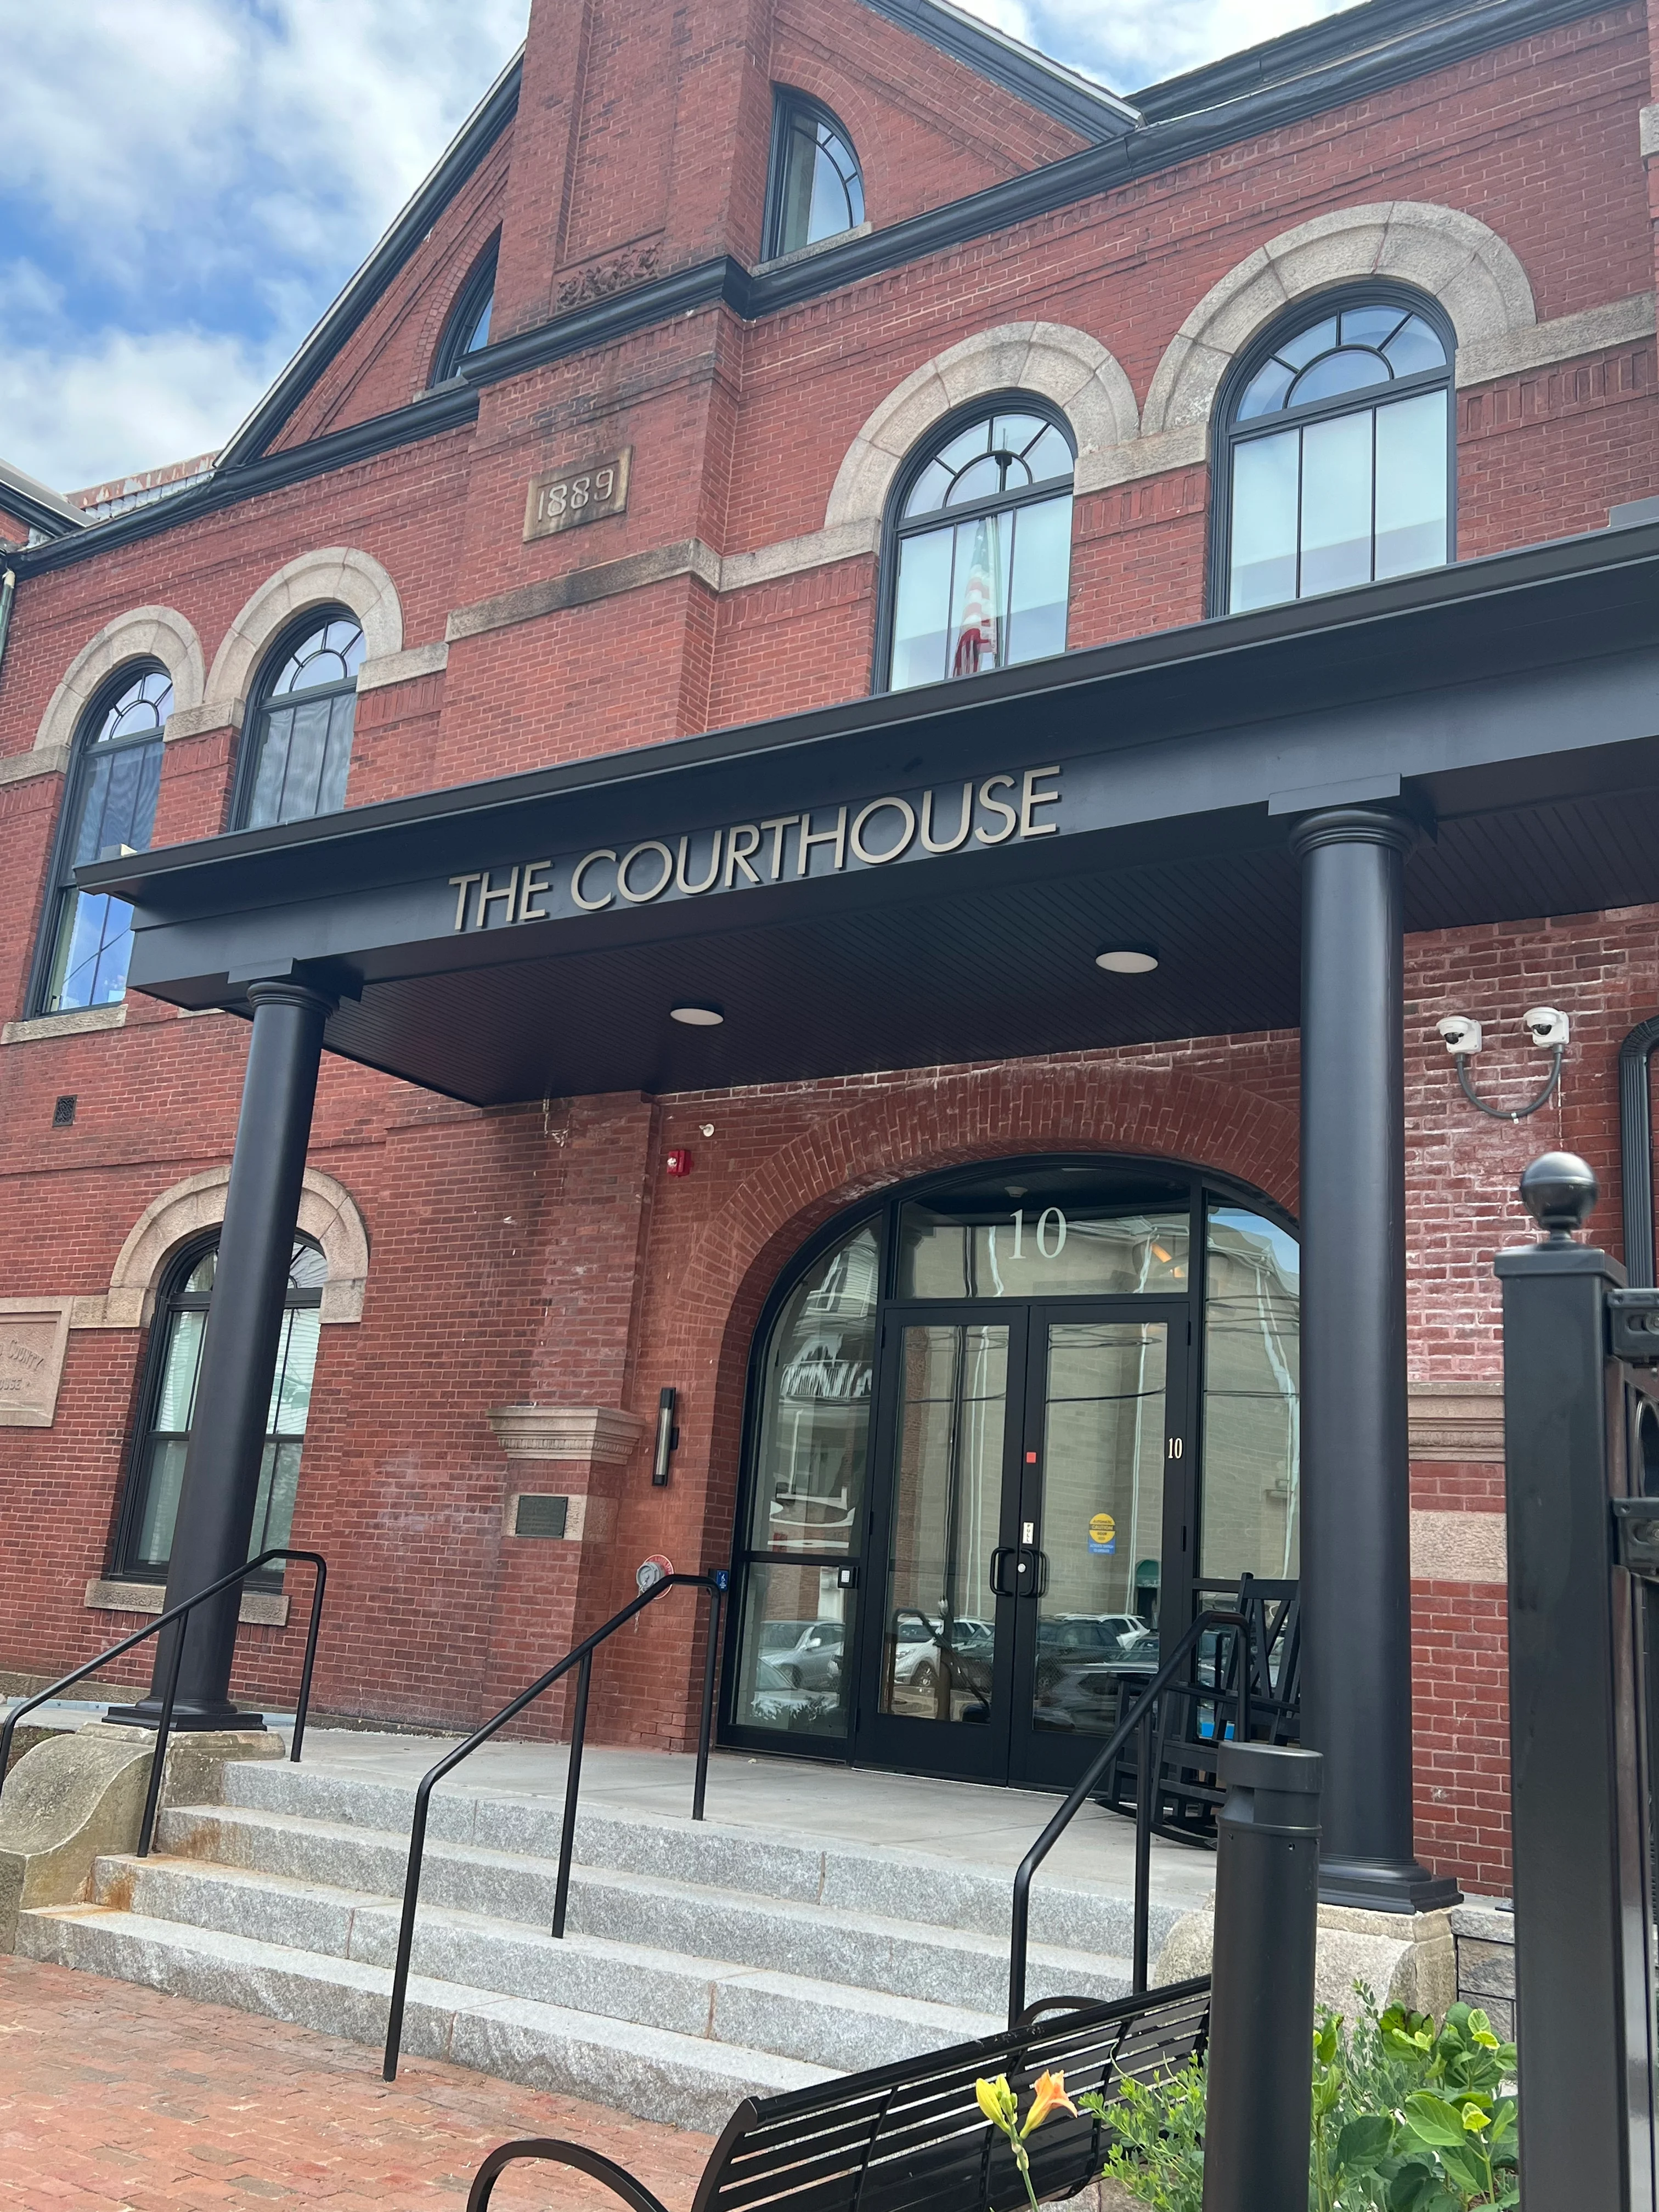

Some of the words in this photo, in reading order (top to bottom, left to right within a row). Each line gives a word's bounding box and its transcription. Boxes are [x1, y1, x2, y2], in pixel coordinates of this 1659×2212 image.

[538, 469, 614, 522] 1889
[448, 860, 551, 930] THE
[571, 765, 1060, 910] COURTHOUSE
[1008, 1207, 1067, 1260] 10
[1168, 1437, 1183, 1459] 10
